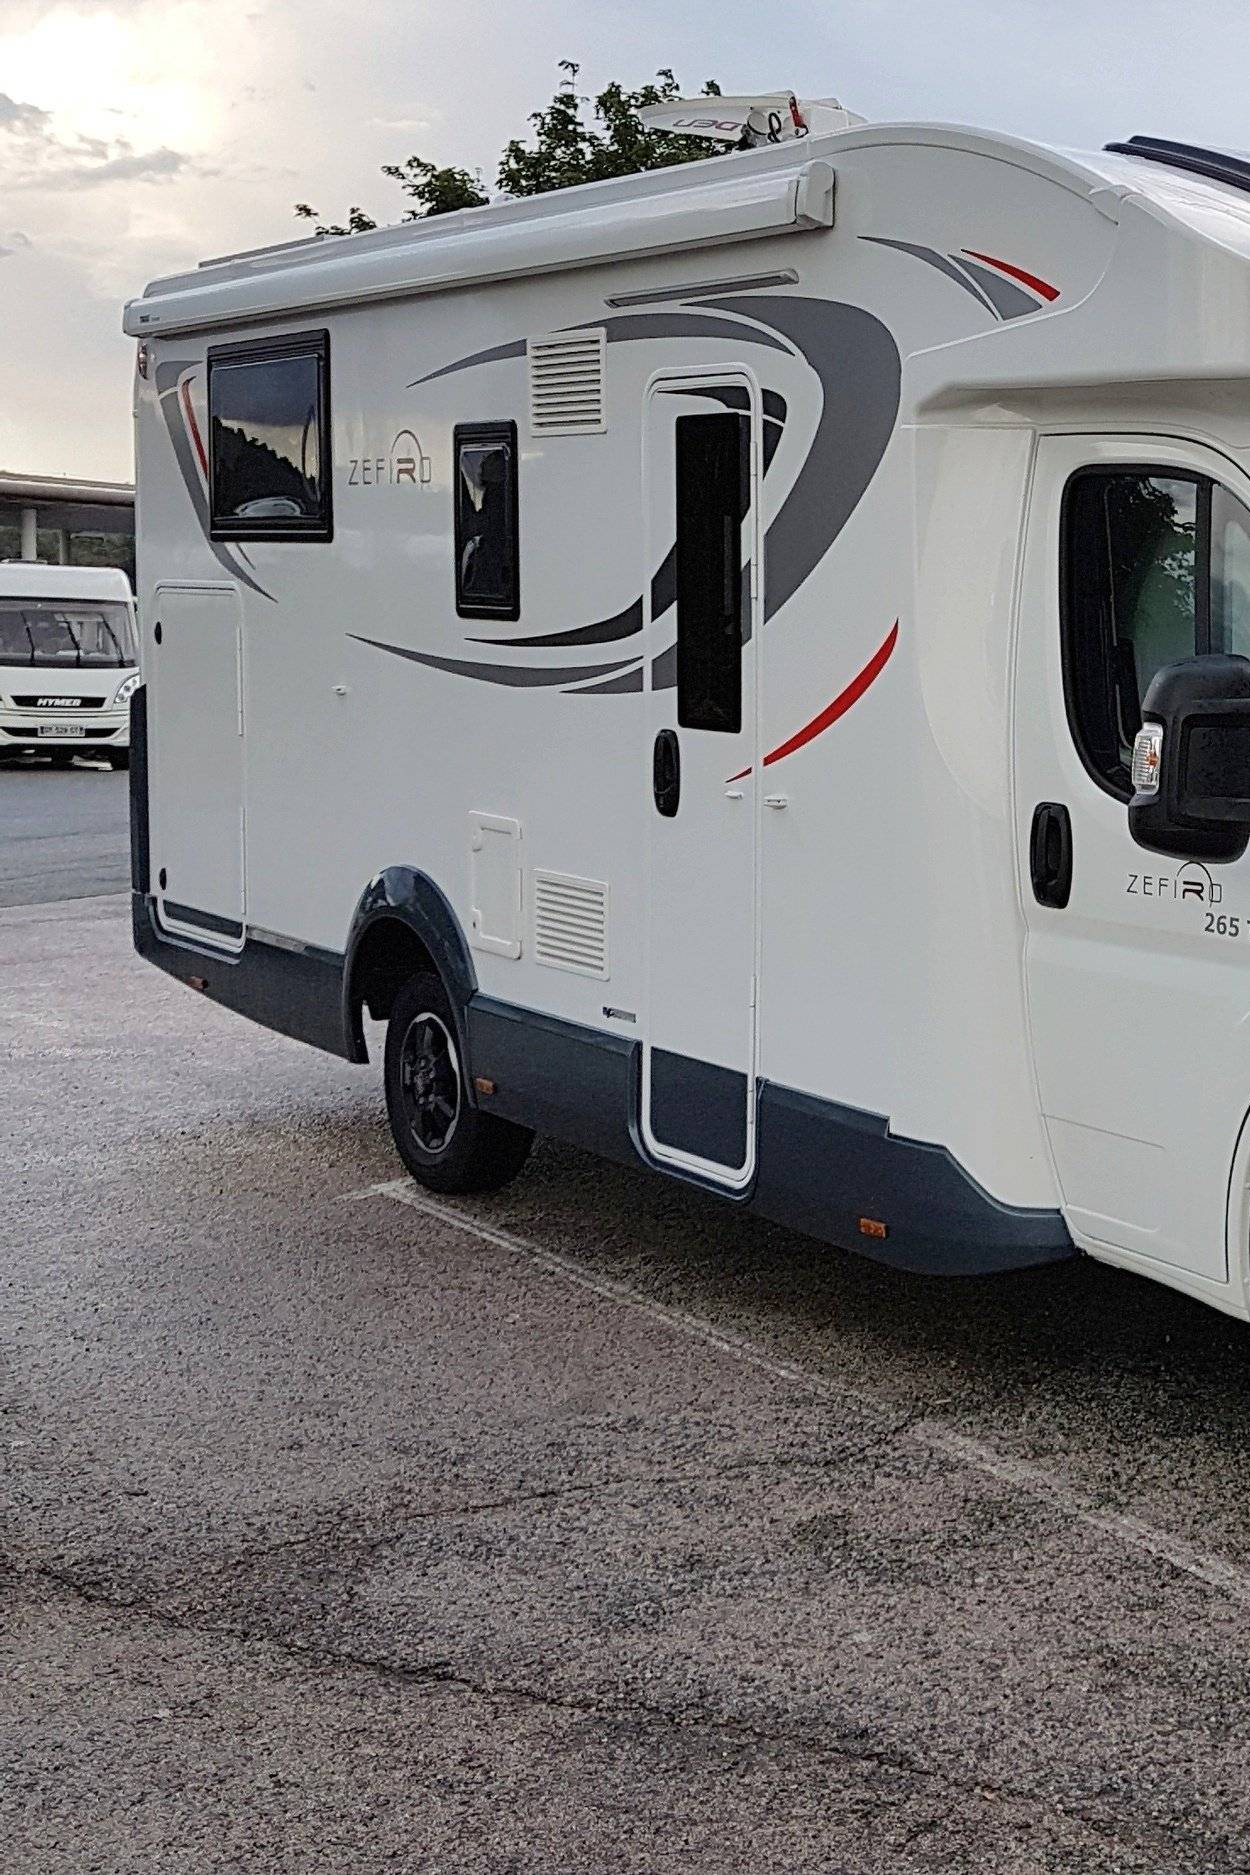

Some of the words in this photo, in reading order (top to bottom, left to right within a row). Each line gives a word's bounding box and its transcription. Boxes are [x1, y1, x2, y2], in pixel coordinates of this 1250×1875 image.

[348, 456, 432, 489] ZEFIRO
[36, 698, 82, 707] HYMER
[1126, 873, 1222, 906] ZEFIRO
[1204, 912, 1240, 938] 265
